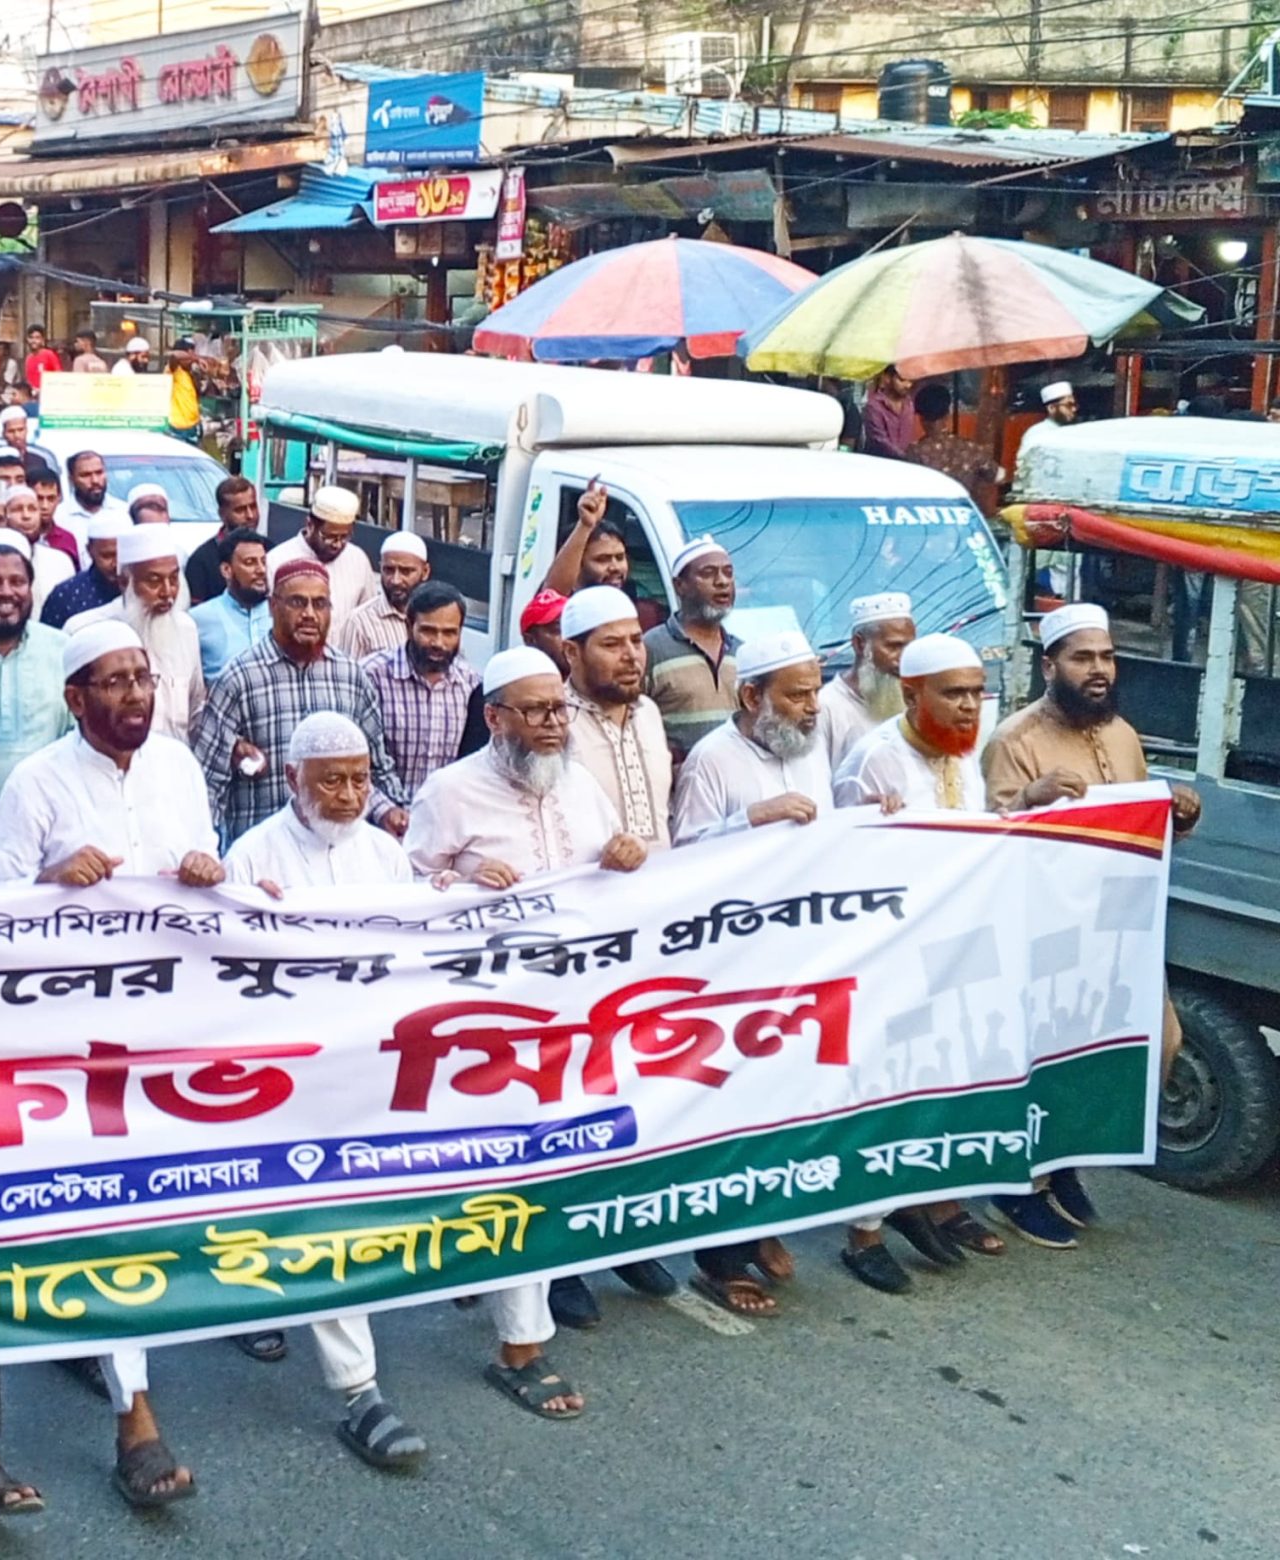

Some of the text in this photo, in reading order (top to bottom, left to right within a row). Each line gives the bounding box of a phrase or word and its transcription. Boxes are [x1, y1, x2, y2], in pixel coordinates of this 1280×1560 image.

[861, 506, 974, 526] HANIF
[449, 892, 557, 932] রাহীম
[212, 952, 396, 1000] মূল্য
[423, 930, 638, 989] বৃদ্ধির
[660, 887, 908, 956] প্রতিবাদে
[379, 975, 858, 1112] মিছিল
[148, 1155, 262, 1196] সোমবার
[338, 1117, 618, 1176] মিশনপাড়া মোড়
[202, 1191, 546, 1295] ইসলামী
[563, 1153, 843, 1240] নারায়ণগঞ্জ
